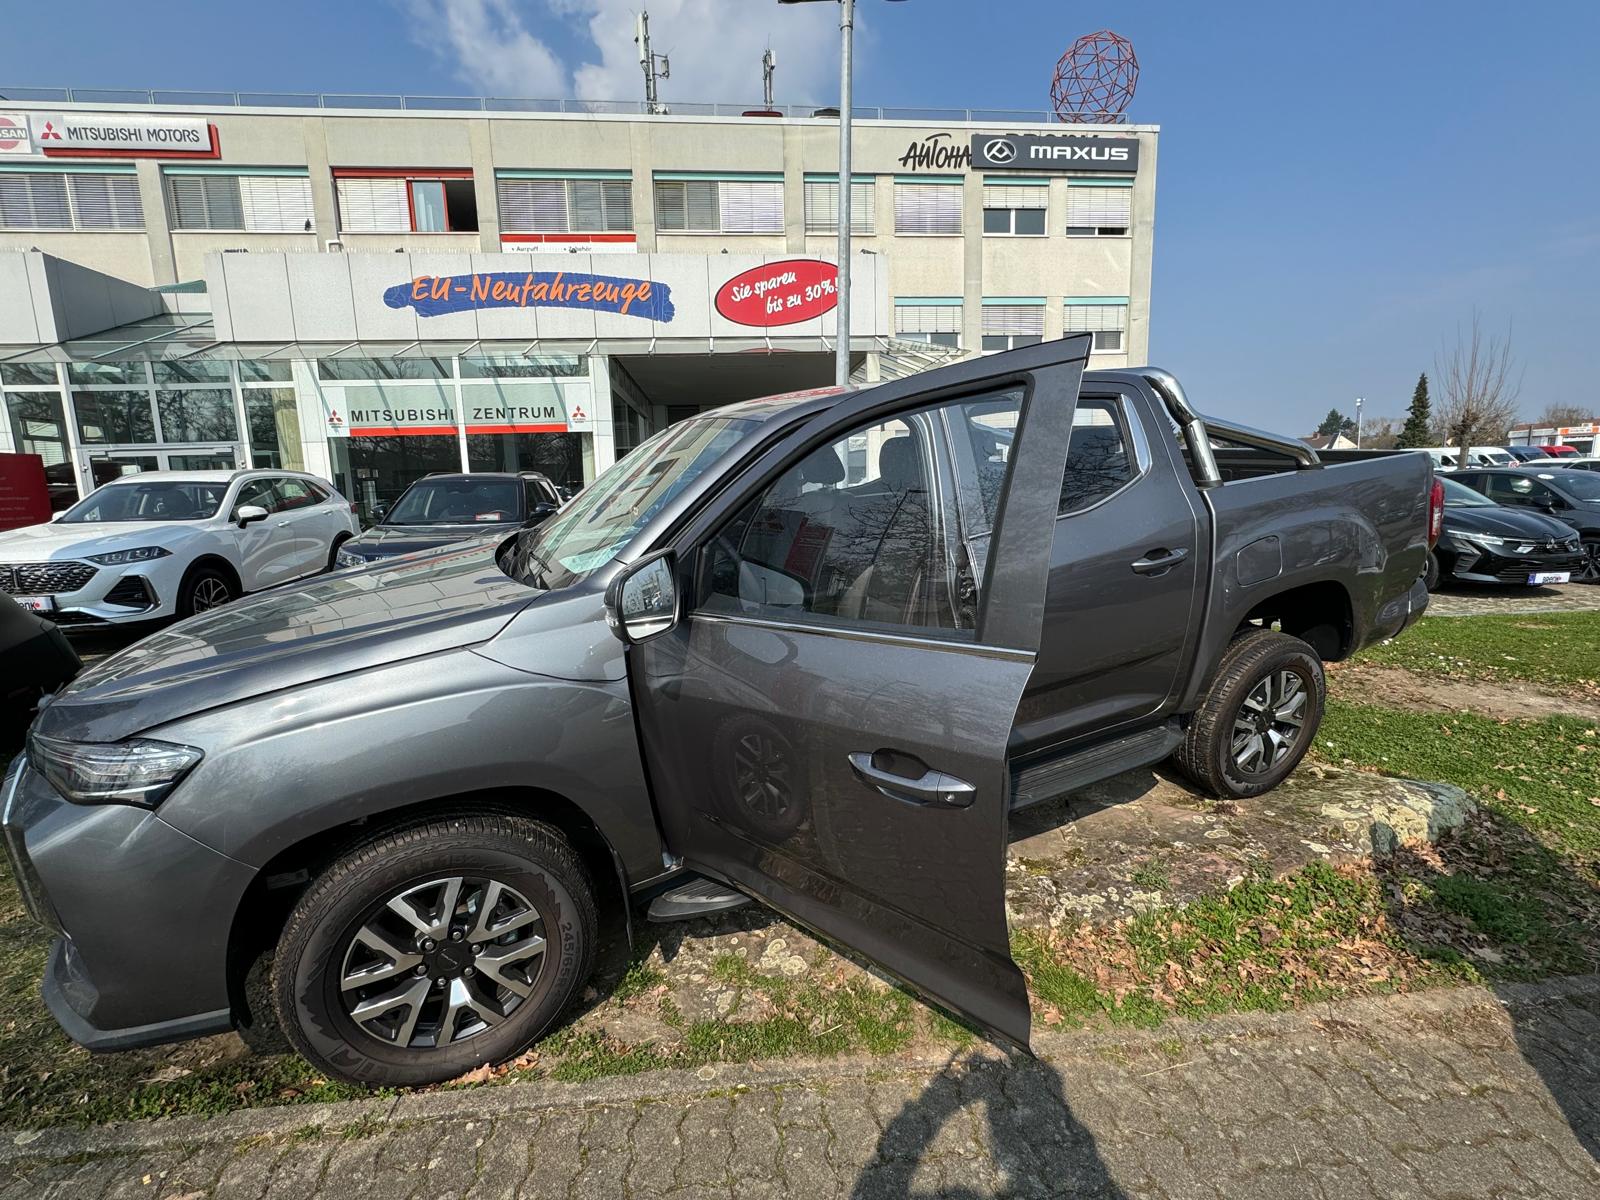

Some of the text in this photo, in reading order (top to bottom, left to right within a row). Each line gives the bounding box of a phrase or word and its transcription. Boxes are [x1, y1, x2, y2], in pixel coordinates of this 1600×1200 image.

[0, 129, 25, 138] SAN
[67, 126, 200, 143] MITSUBISHI MOTORS
[1030, 145, 1128, 161] MAXUS
[410, 271, 652, 314] EU-Neufahrzeuge
[731, 271, 797, 301] Sie sparen
[766, 276, 839, 314] bis zu 30%!
[351, 406, 556, 423] MITSUBISHI ZENTRUM
